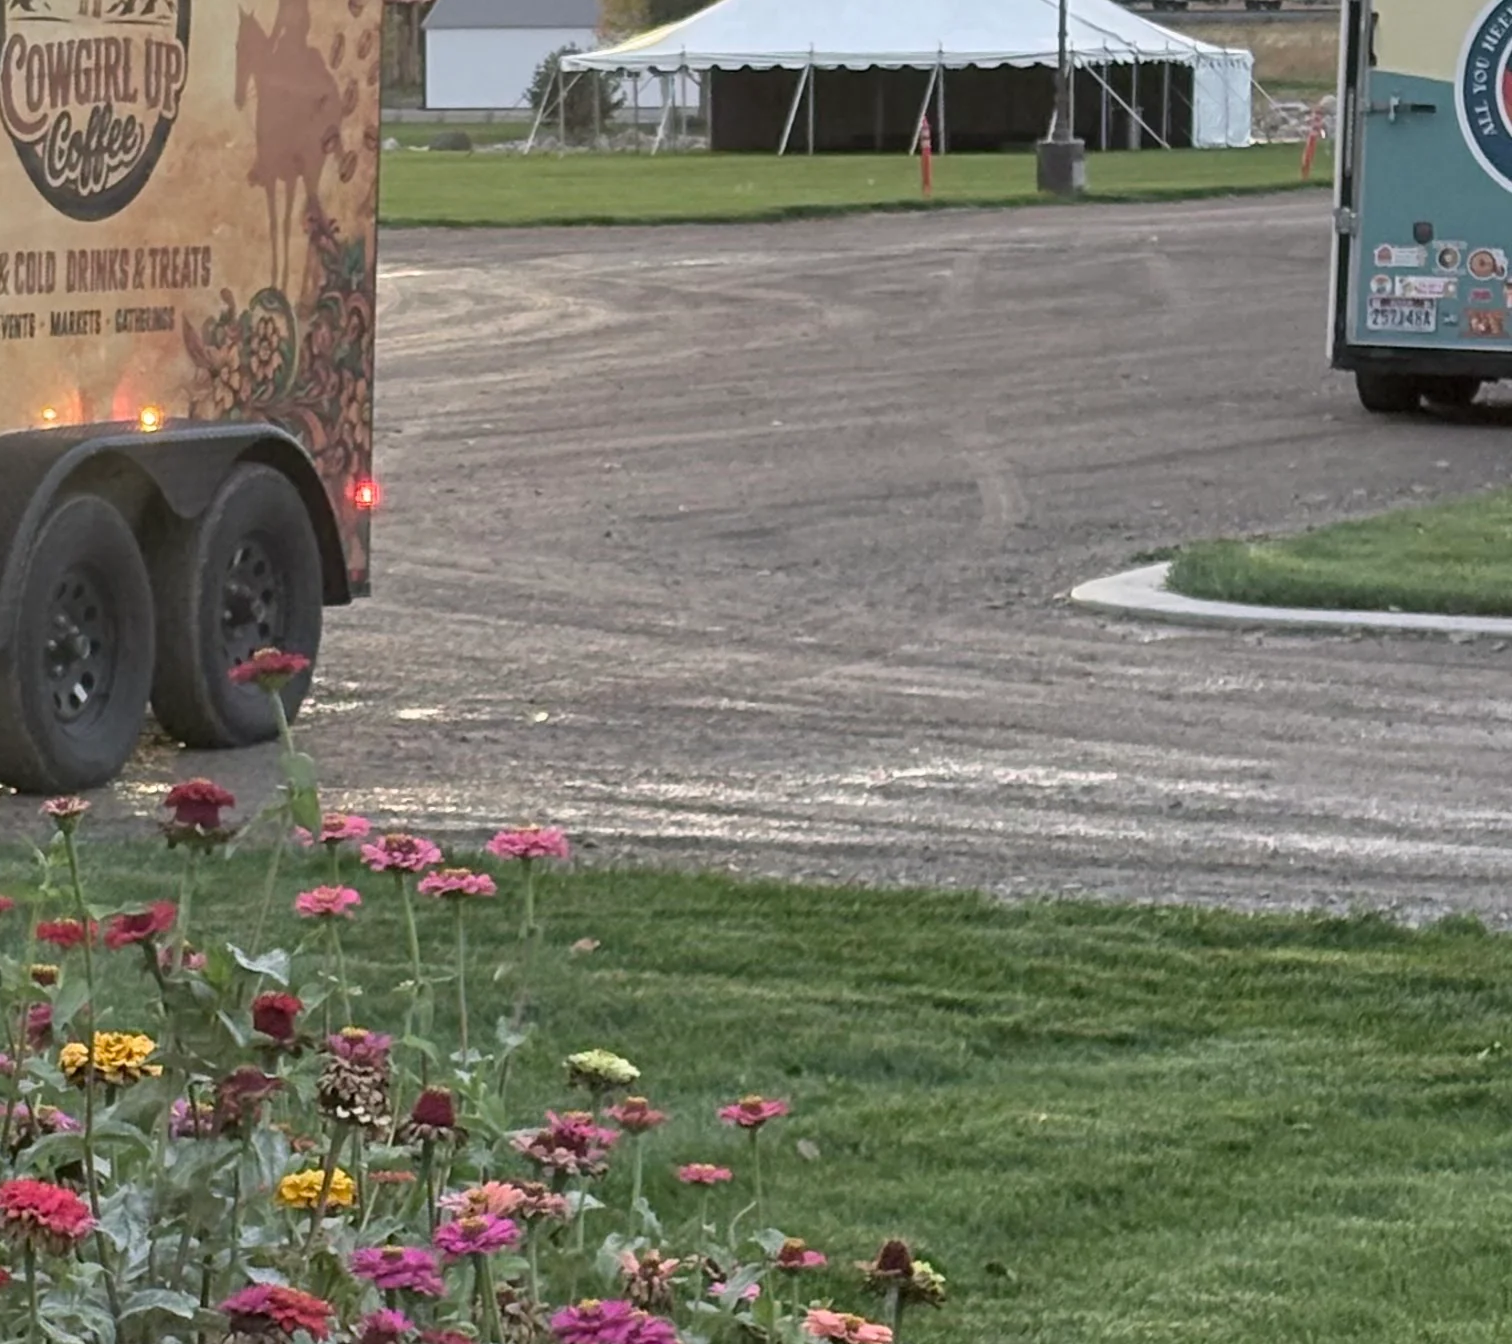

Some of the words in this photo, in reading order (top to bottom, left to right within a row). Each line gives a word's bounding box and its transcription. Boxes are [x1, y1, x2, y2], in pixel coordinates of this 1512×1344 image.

[144, 37, 183, 112] UP
[1473, 56, 1491, 94] YOU
[1474, 99, 1498, 136] ALL
[47, 102, 145, 190] Coffee
[13, 251, 56, 295] COLD
[65, 247, 130, 294] DRINKS
[132, 247, 146, 290] &
[148, 244, 212, 290] TREATS
[49, 309, 102, 337] MARKETS
[114, 306, 175, 334] GATHERINGS
